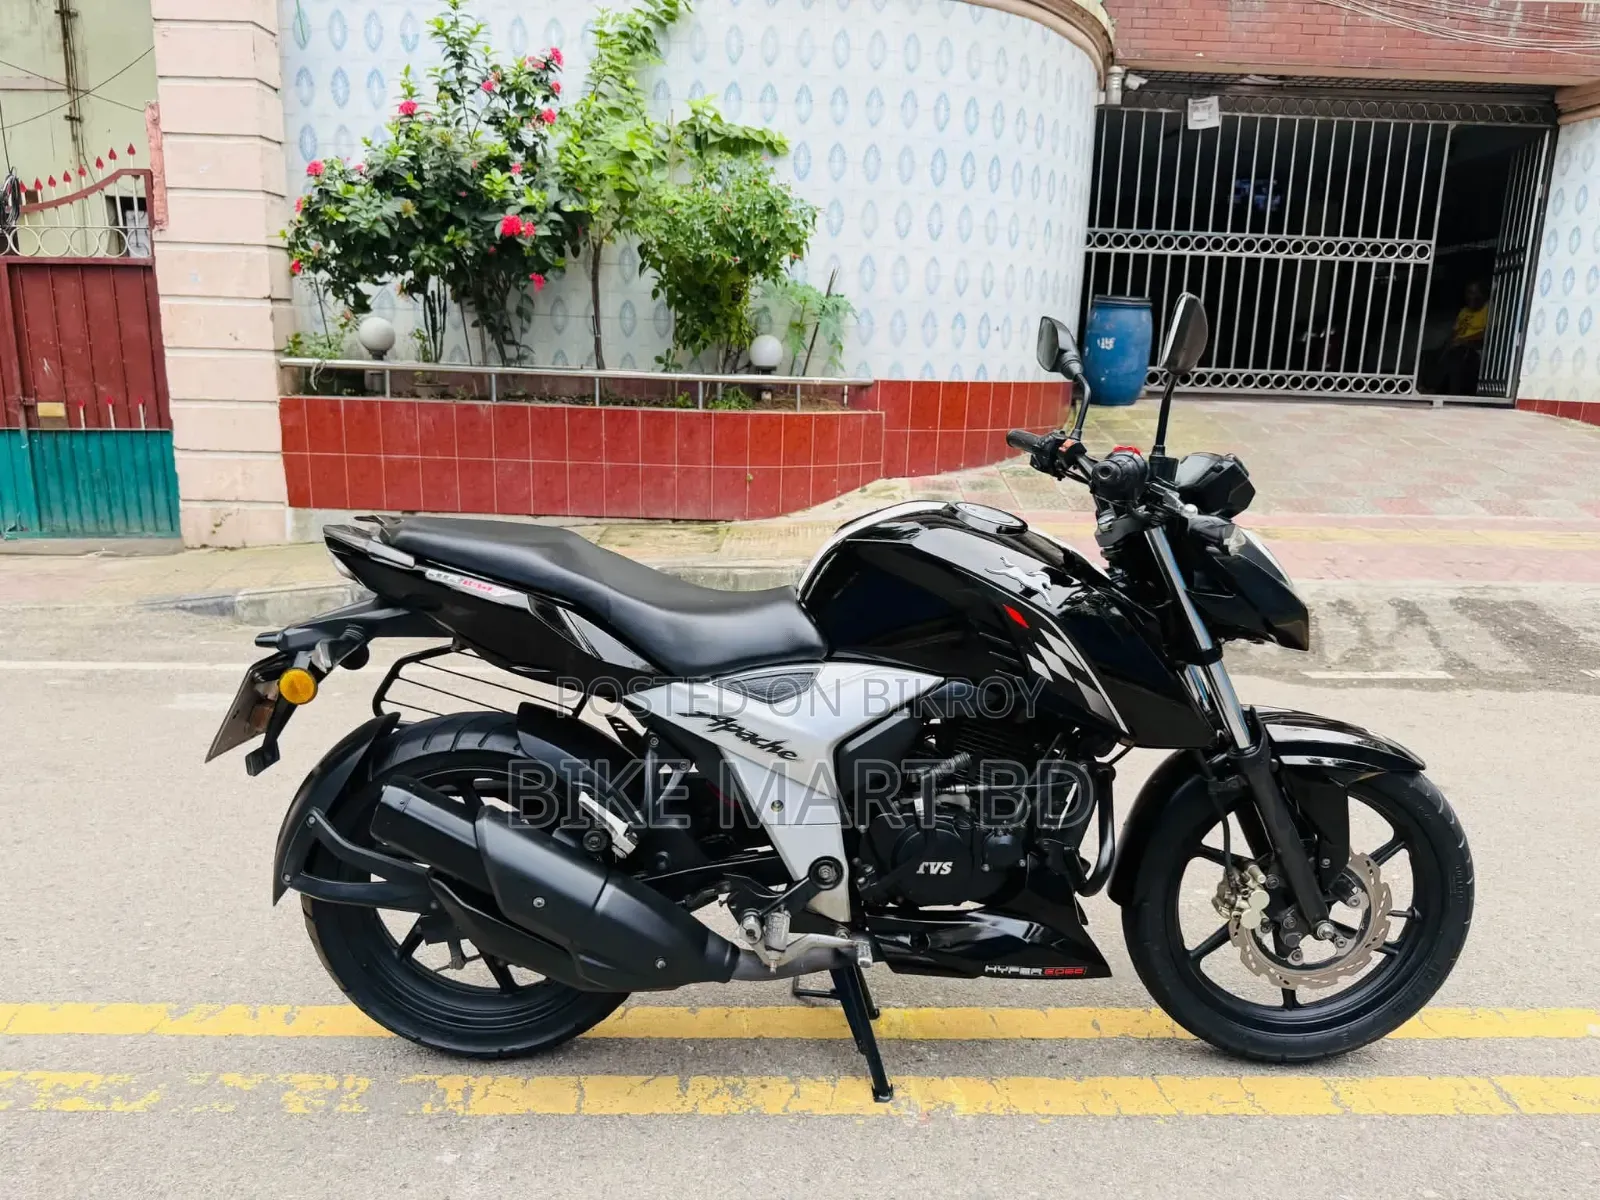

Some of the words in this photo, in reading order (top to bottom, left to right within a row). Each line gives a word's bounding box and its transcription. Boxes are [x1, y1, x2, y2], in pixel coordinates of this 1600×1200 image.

[676, 711, 798, 761] Apache
[916, 861, 953, 875] TVS
[985, 965, 1043, 976] HYPER
